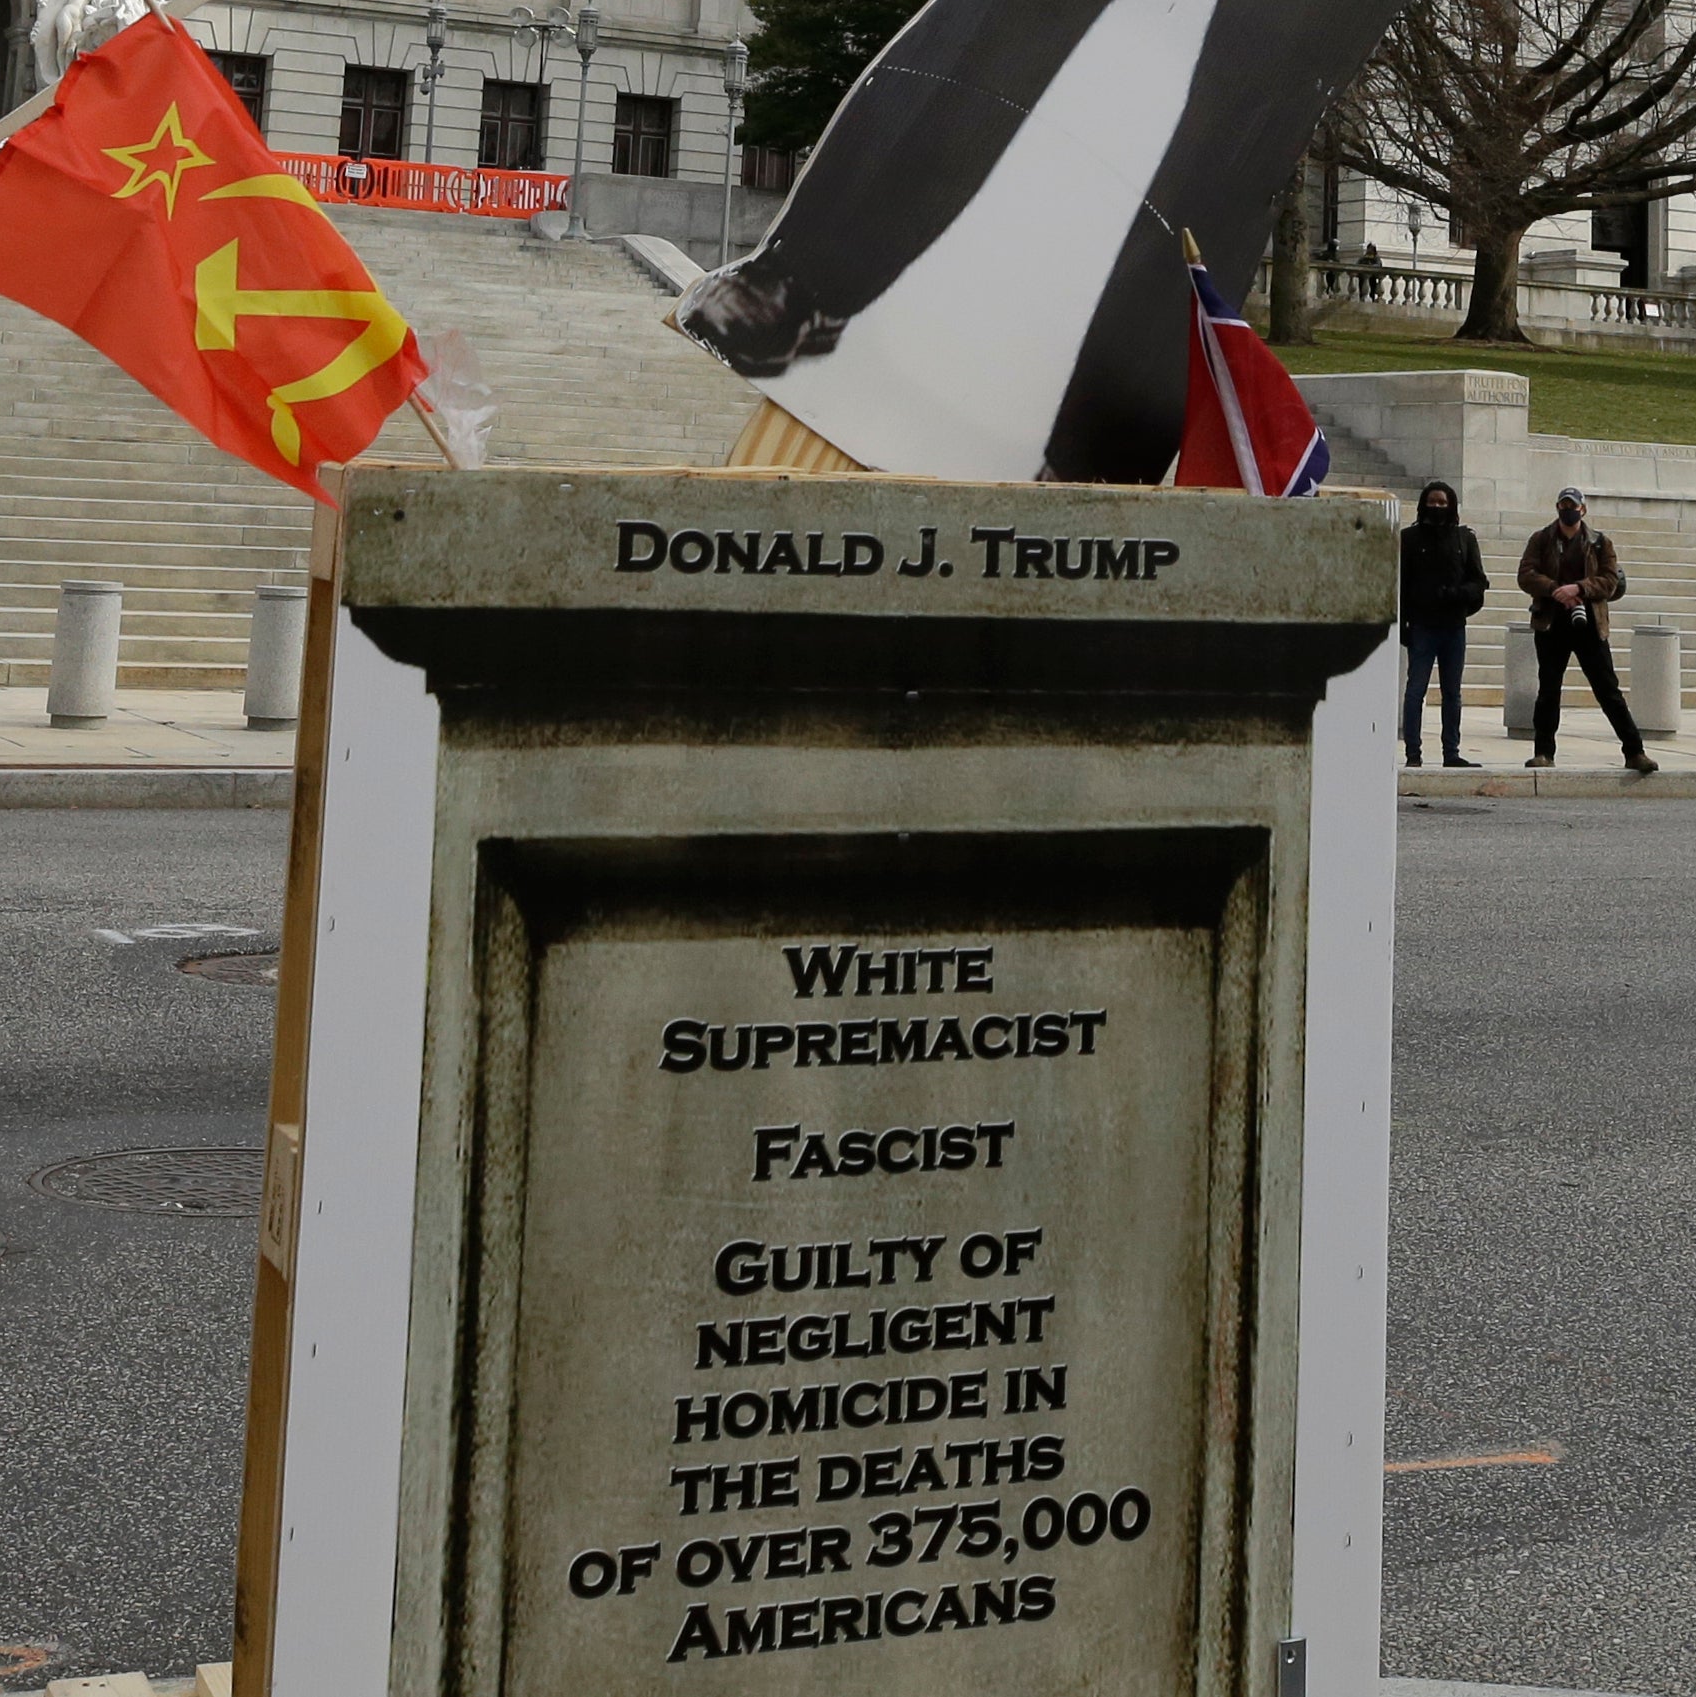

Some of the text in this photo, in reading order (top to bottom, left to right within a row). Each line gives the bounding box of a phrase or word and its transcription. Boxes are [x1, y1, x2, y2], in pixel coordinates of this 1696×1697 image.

[1466, 375, 1528, 392] TRUTH FOR
[1466, 390, 1528, 404] AUTHORITY
[614, 519, 1181, 581] DONALD J. TRUMP
[781, 942, 994, 999] WHITE
[658, 1008, 1107, 1074] SUPREMACIST
[751, 1119, 1016, 1183] FASCIST
[714, 1226, 1043, 1297] GUILTY OF
[694, 1294, 1056, 1370] NEGLIGENT
[672, 1363, 1068, 1445] HOMICIDE IN
[668, 1435, 1066, 1515] THE DEATHS
[567, 1486, 1152, 1600] OF OVER 375,000
[665, 1573, 1057, 1663] AMERICANS
